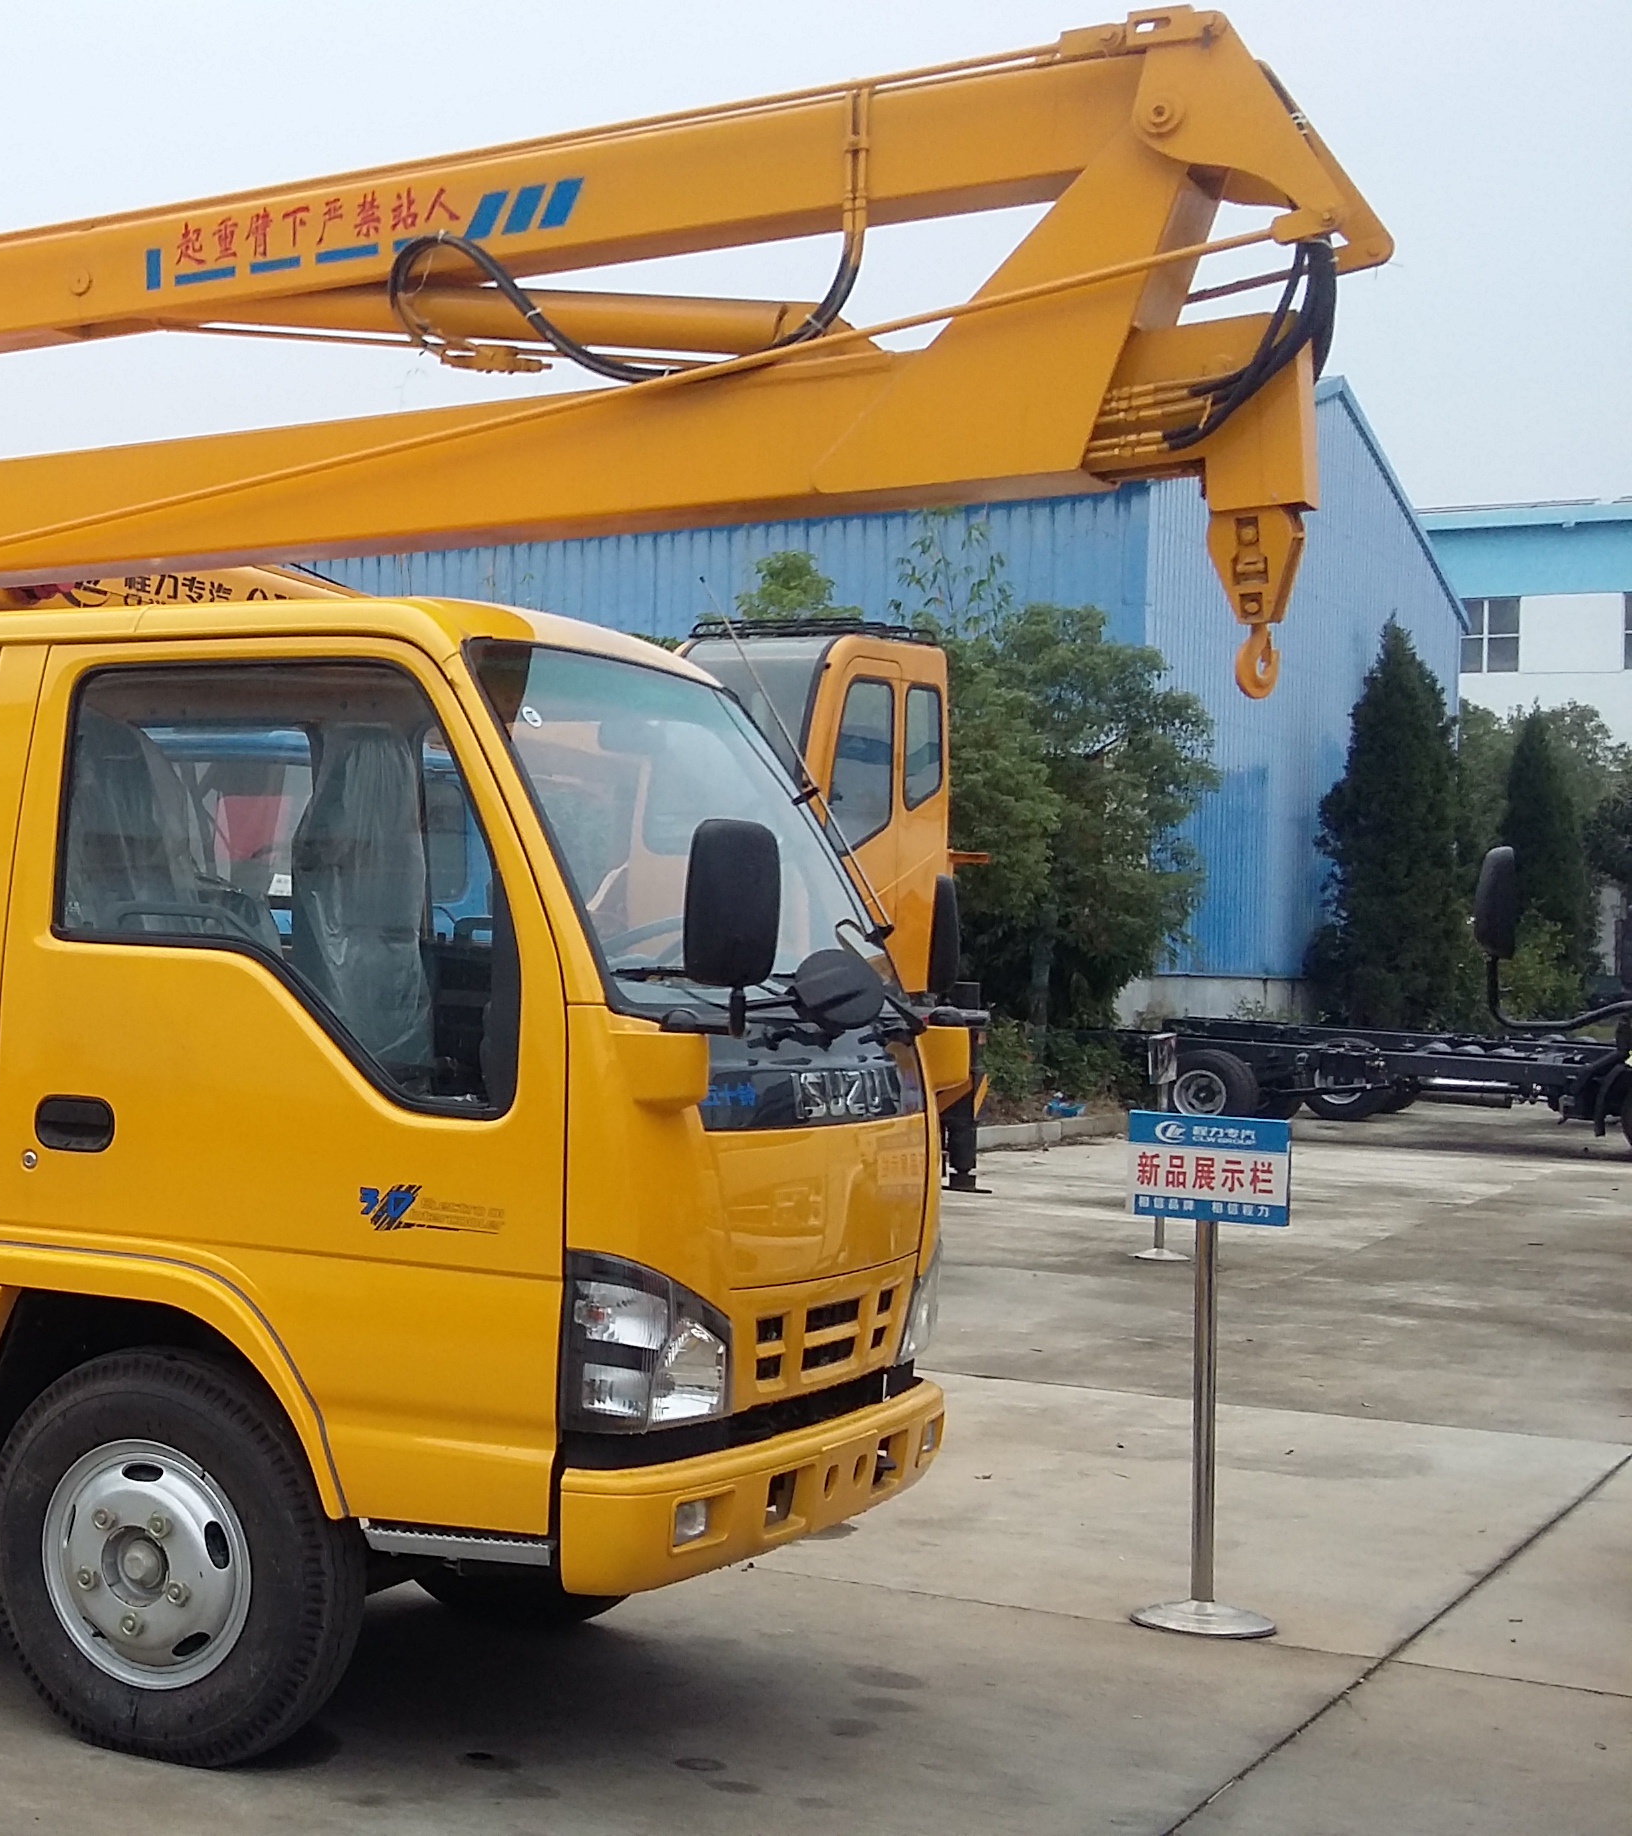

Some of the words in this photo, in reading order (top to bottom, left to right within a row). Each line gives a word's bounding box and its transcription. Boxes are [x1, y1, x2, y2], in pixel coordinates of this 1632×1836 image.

[175, 186, 461, 266] 起重臂下严禁站人
[789, 1068, 883, 1120] ISUZU
[1192, 1125, 1257, 1140] 程力专汽
[1192, 1135, 1217, 1144] CLW
[1218, 1137, 1257, 1146] GROUP
[1136, 1151, 1274, 1195] 新品展示栏
